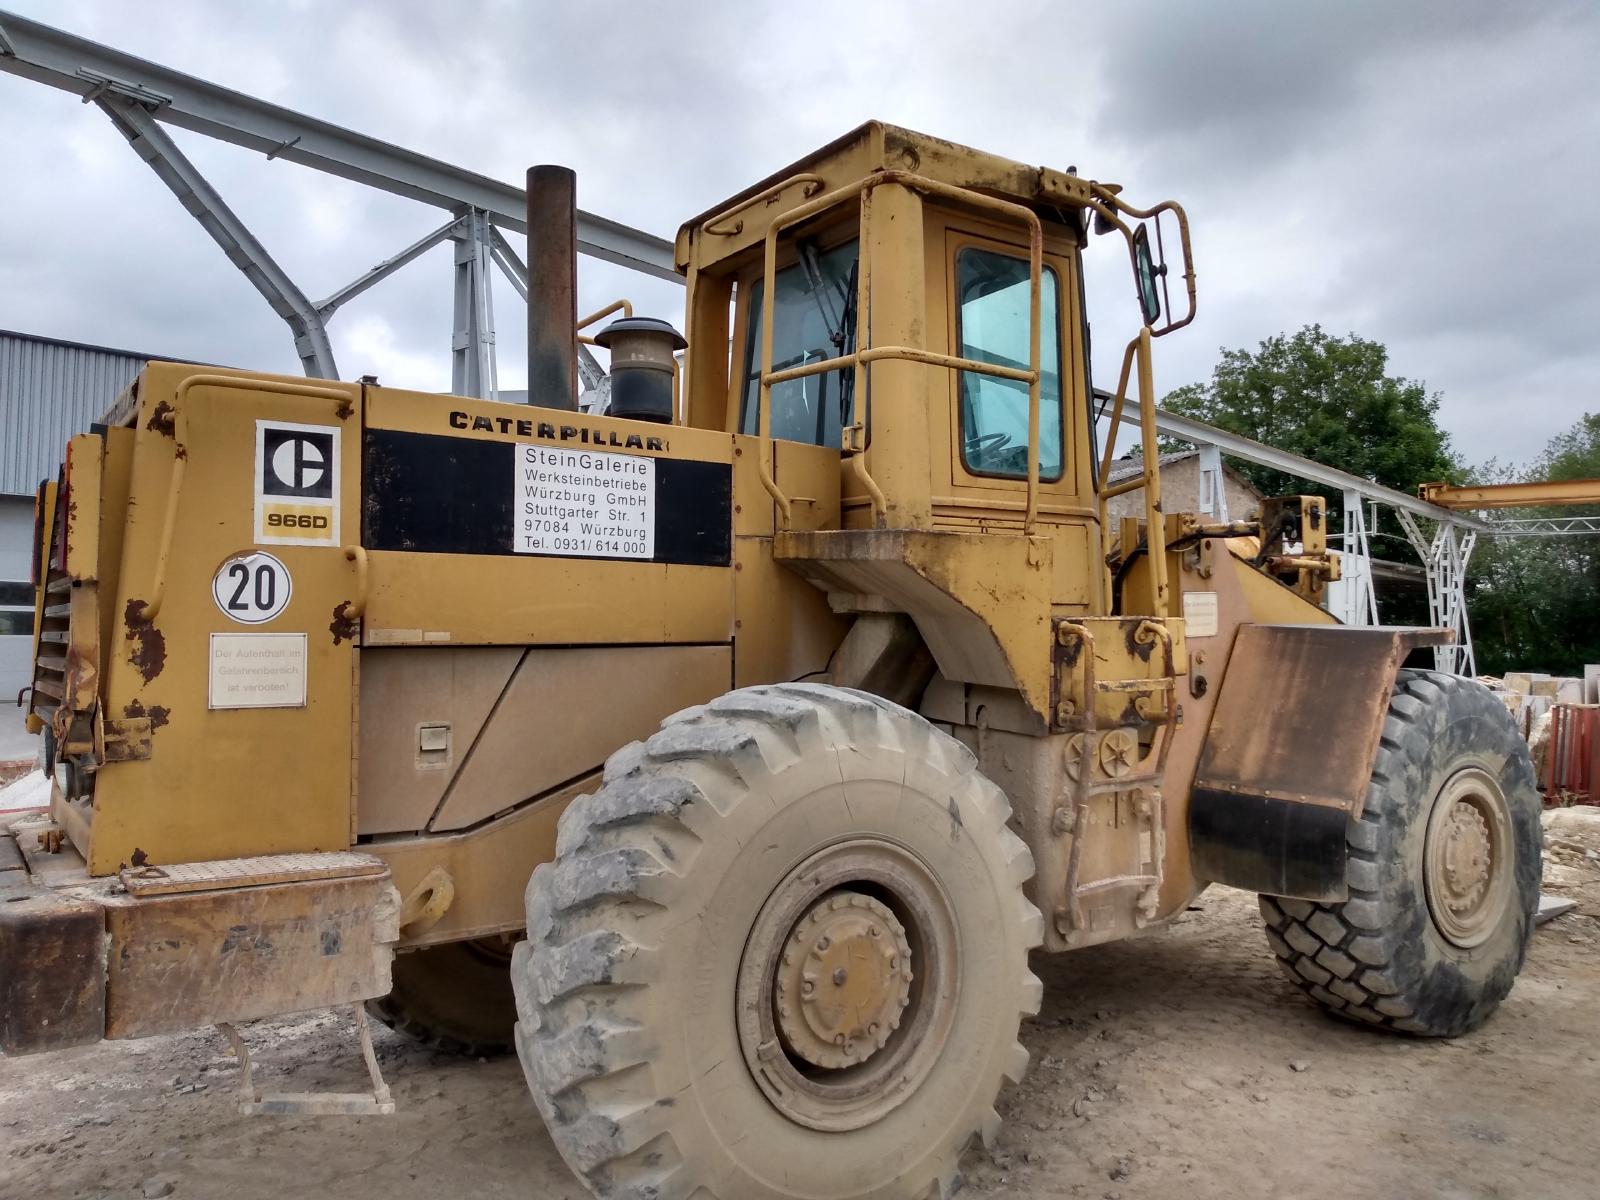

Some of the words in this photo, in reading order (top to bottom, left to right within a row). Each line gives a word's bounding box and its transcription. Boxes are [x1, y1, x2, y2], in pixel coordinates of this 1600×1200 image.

[449, 411, 668, 451] CATERPILLAR
[525, 448, 647, 475] SteinGalerie
[525, 469, 647, 491] Werksteinbetriebe
[525, 485, 595, 505] Würzburg
[606, 492, 646, 507] GmbH
[267, 513, 328, 529] 966D
[525, 502, 599, 520] Stuttgarter
[608, 508, 630, 521] Str.
[639, 511, 646, 523] 1
[524, 519, 569, 534] 97084
[580, 522, 646, 540] Würzburg
[524, 535, 549, 549] Tel.
[595, 539, 619, 552] 614
[623, 541, 646, 554] 000
[228, 563, 275, 610] 20
